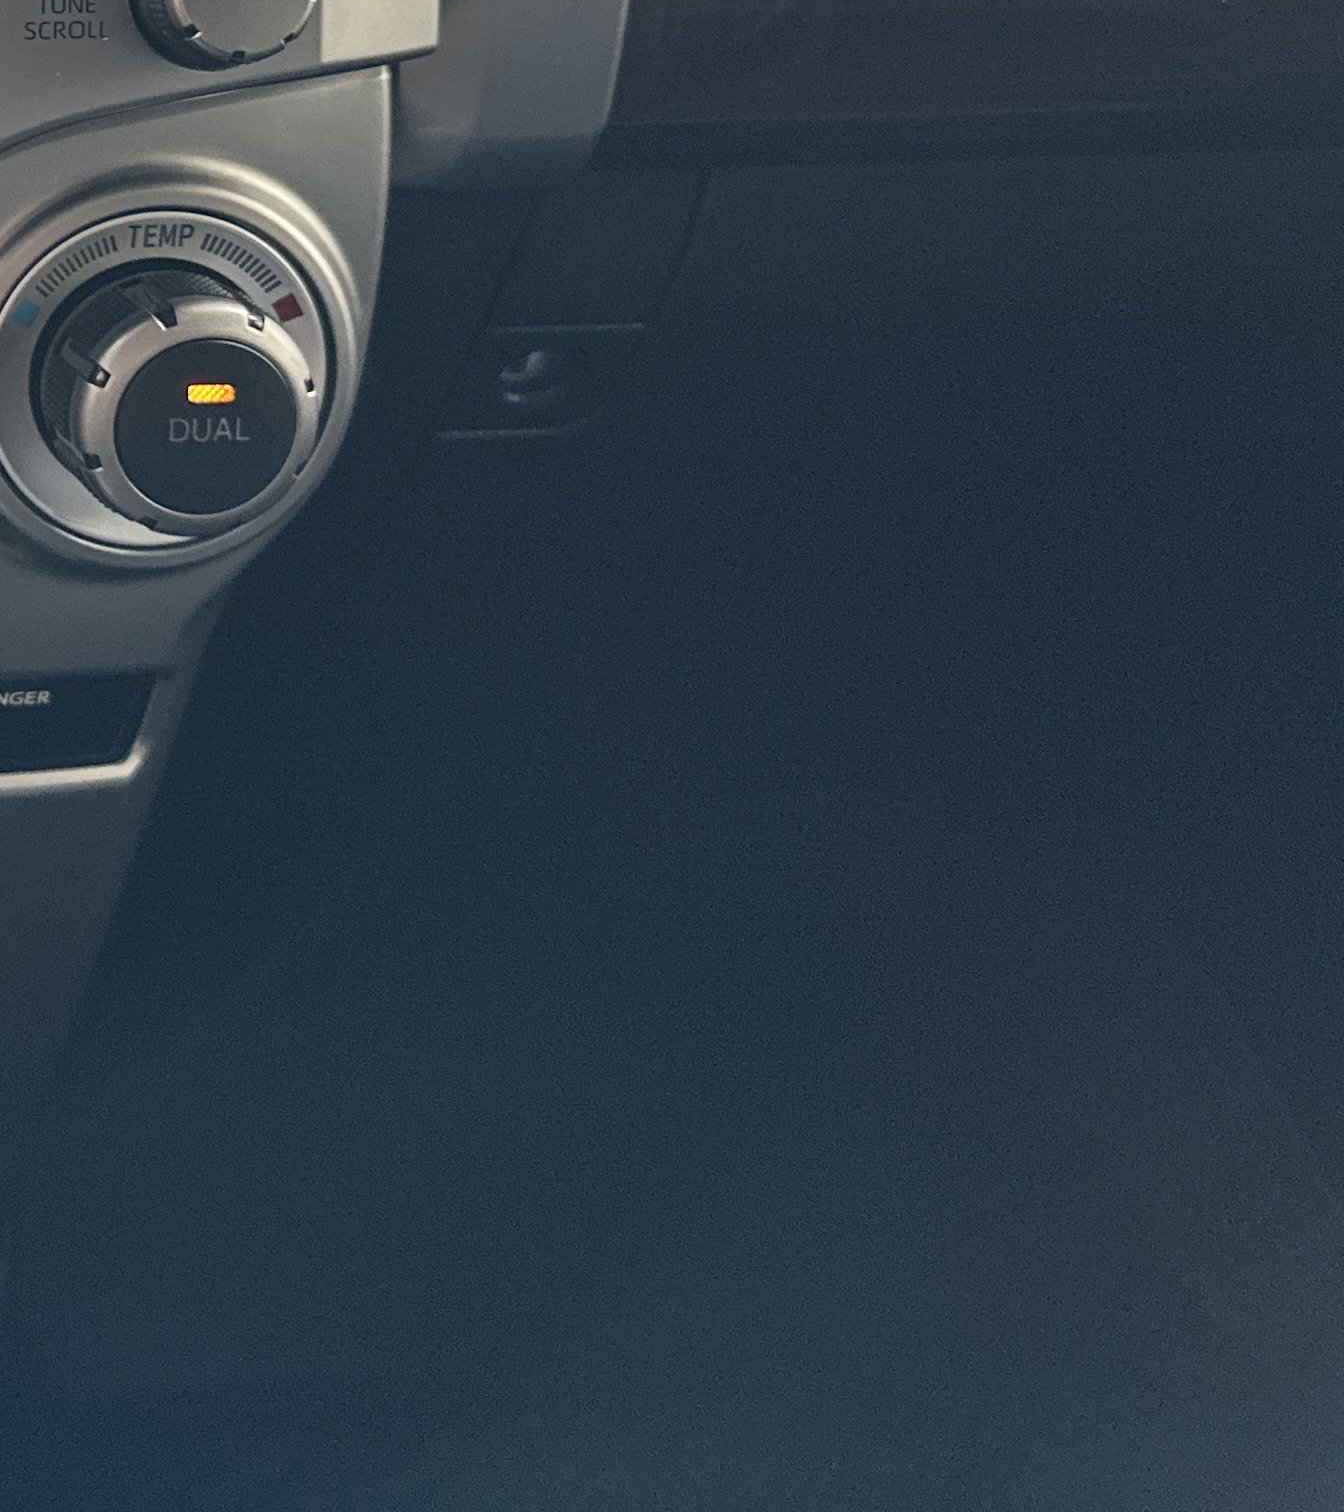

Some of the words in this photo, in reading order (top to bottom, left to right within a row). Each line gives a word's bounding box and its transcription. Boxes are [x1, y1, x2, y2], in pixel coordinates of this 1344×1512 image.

[23, 19, 109, 41] SCROLL
[127, 224, 195, 249] TEMP
[167, 418, 250, 443] DUAL
